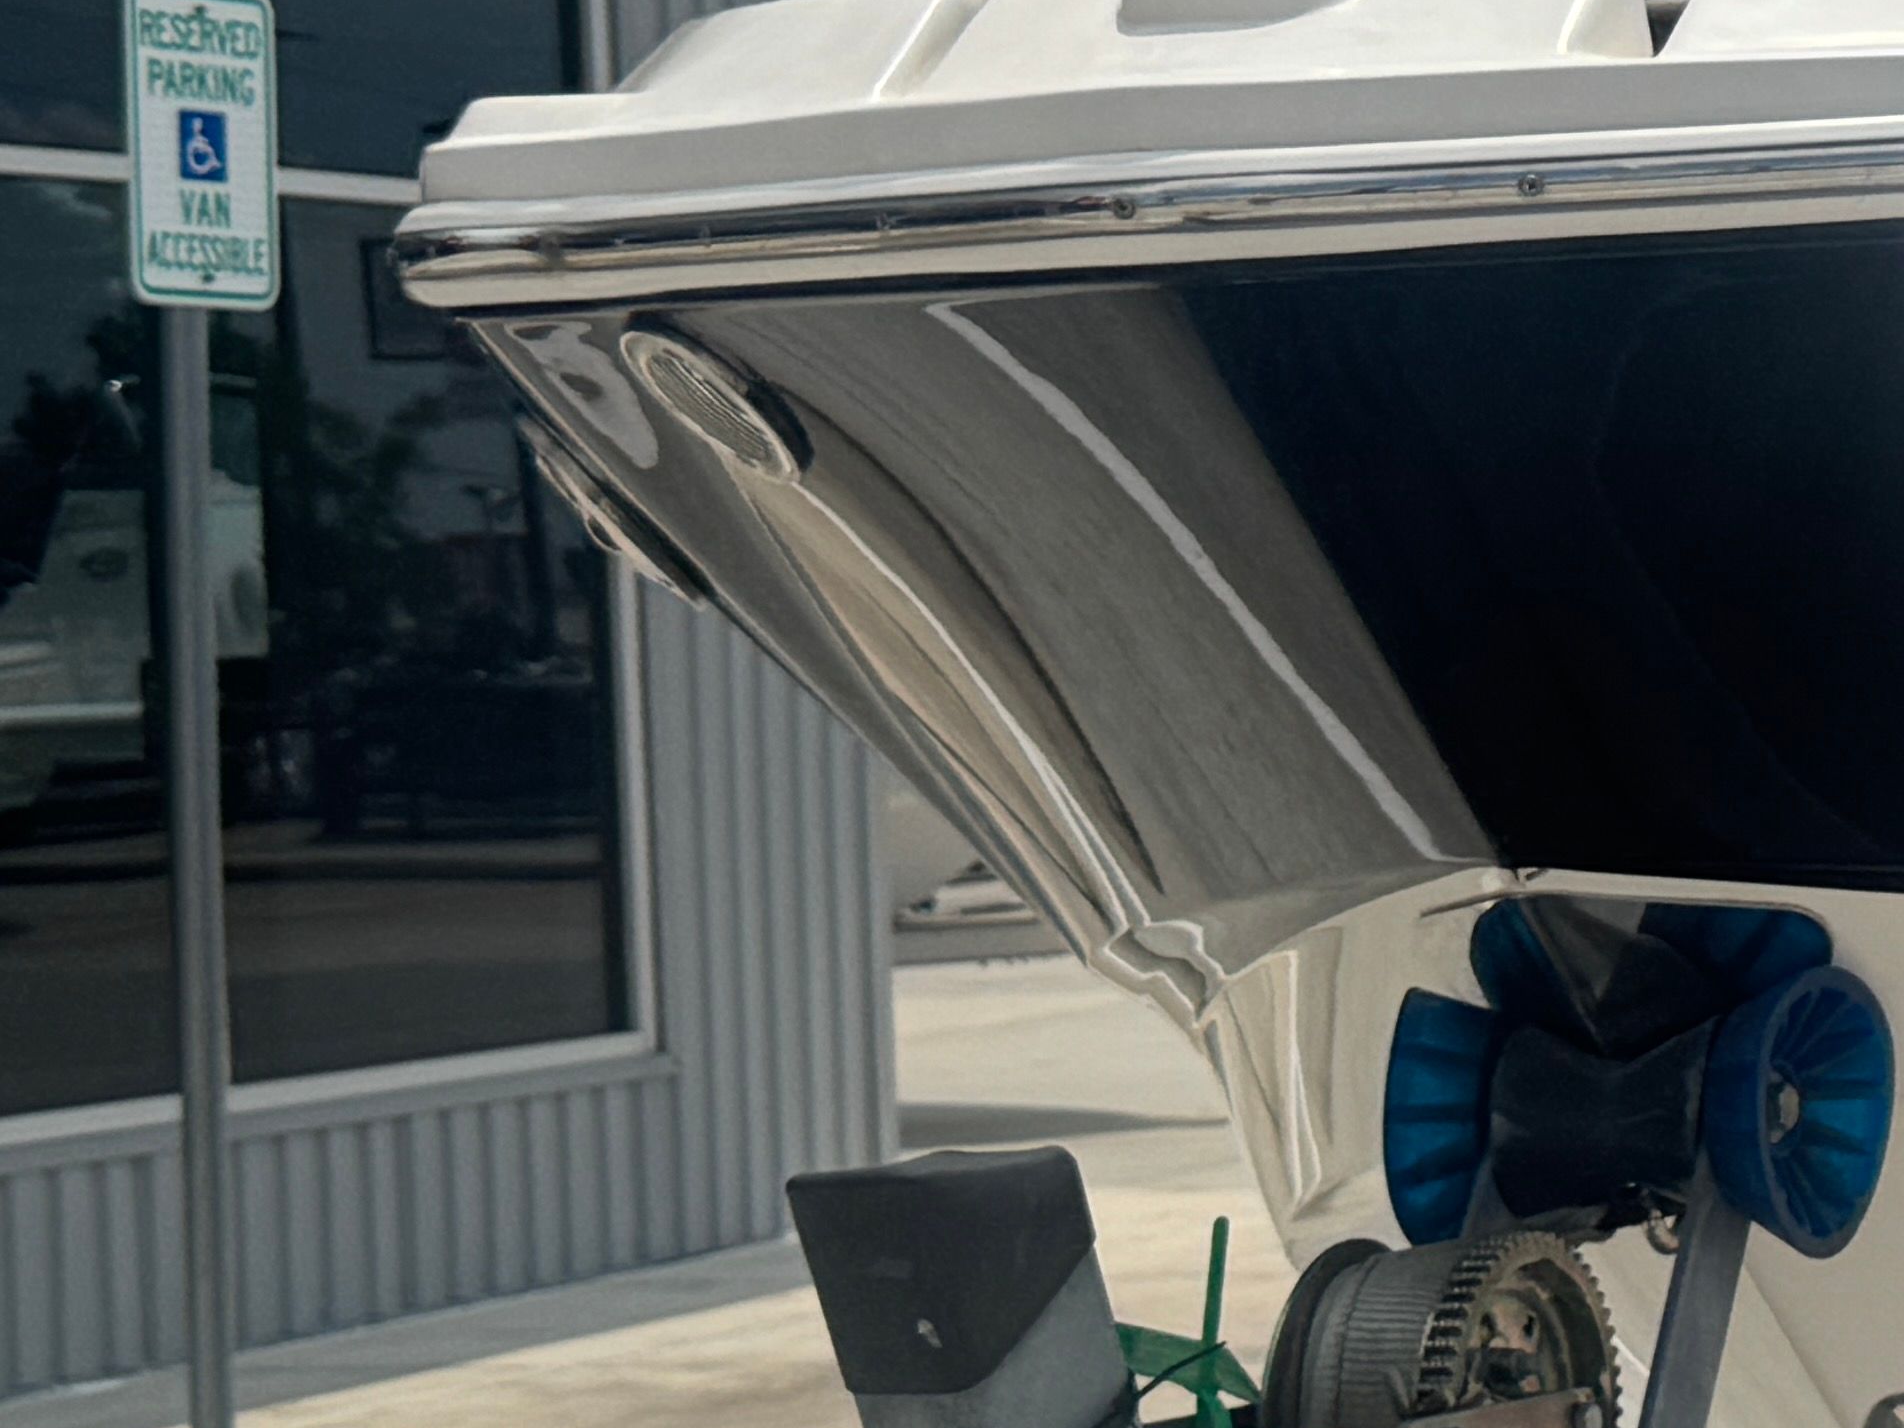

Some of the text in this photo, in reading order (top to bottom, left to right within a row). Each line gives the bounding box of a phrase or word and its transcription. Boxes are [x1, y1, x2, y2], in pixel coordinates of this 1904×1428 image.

[139, 8, 261, 59] RESERVED
[147, 57, 256, 107] PARKING
[180, 189, 231, 226] VAN
[148, 230, 267, 276] ACCESSIBLE
